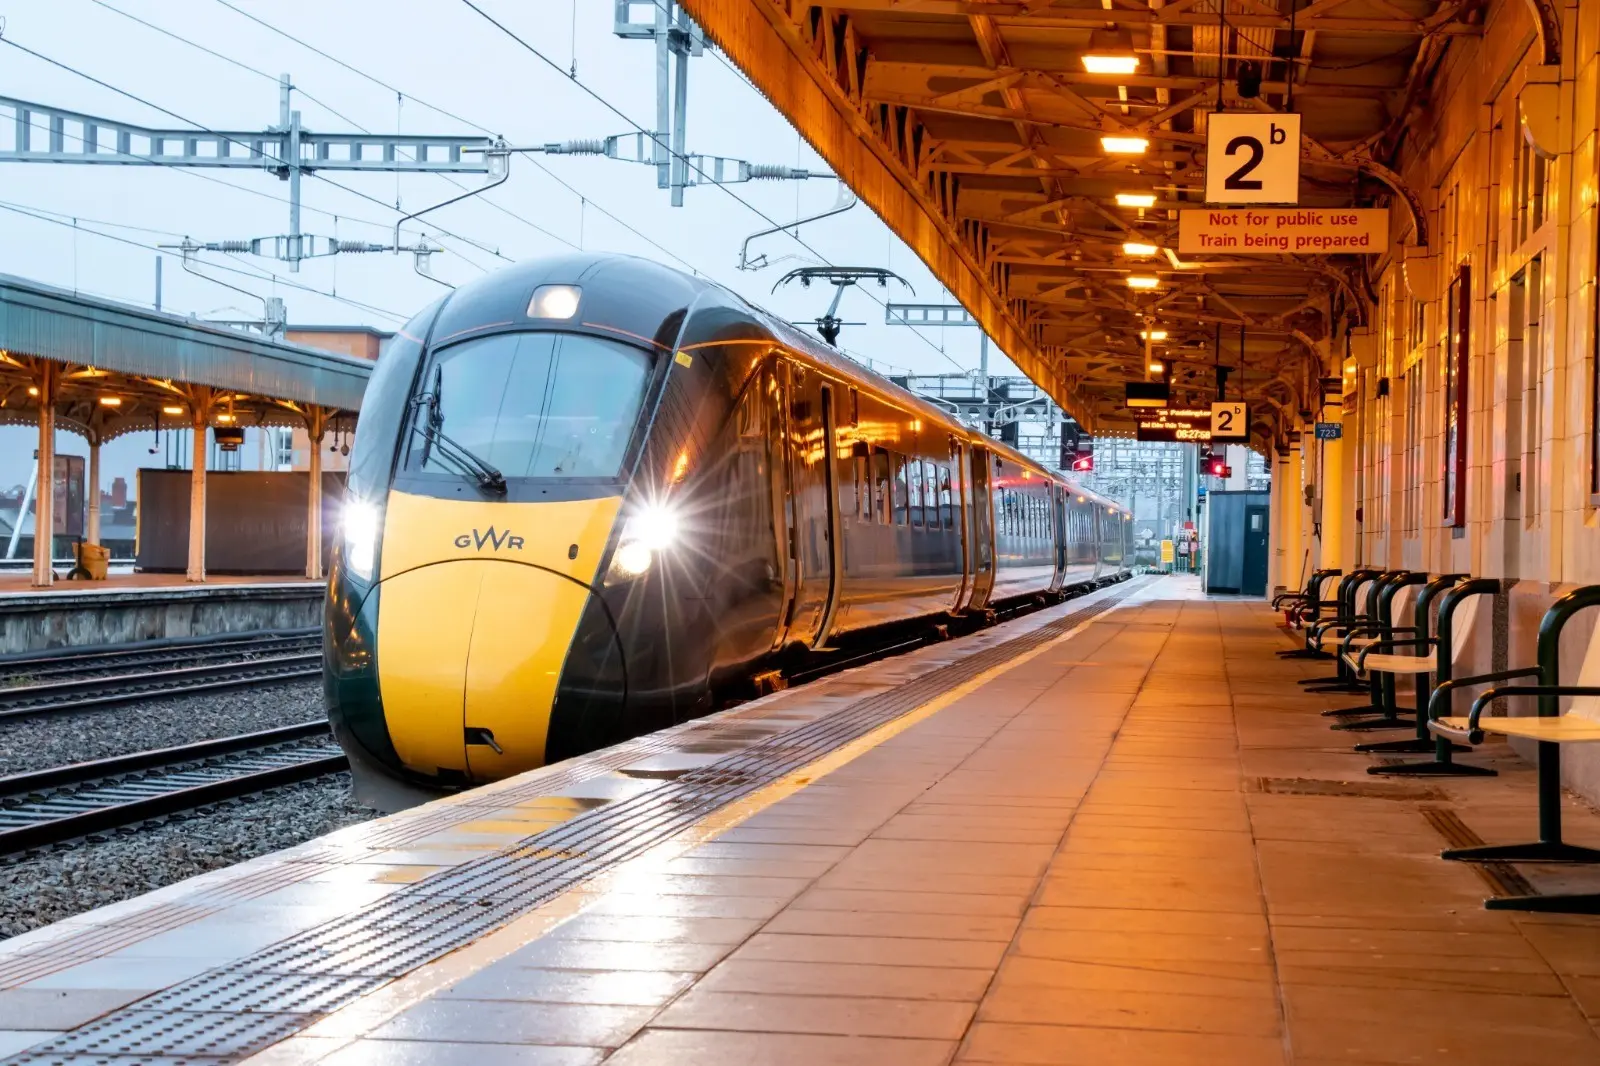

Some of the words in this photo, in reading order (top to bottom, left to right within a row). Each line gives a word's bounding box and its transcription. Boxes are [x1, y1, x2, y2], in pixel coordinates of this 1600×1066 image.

[1209, 213, 1238, 226] Not
[1246, 212, 1269, 225] for
[1276, 212, 1323, 229] public
[1330, 214, 1358, 226] use
[1198, 233, 1237, 247] Train
[1244, 233, 1288, 250] being
[1295, 232, 1370, 250] prepared
[1320, 429, 1336, 438] 723
[454, 525, 525, 552] GWR
